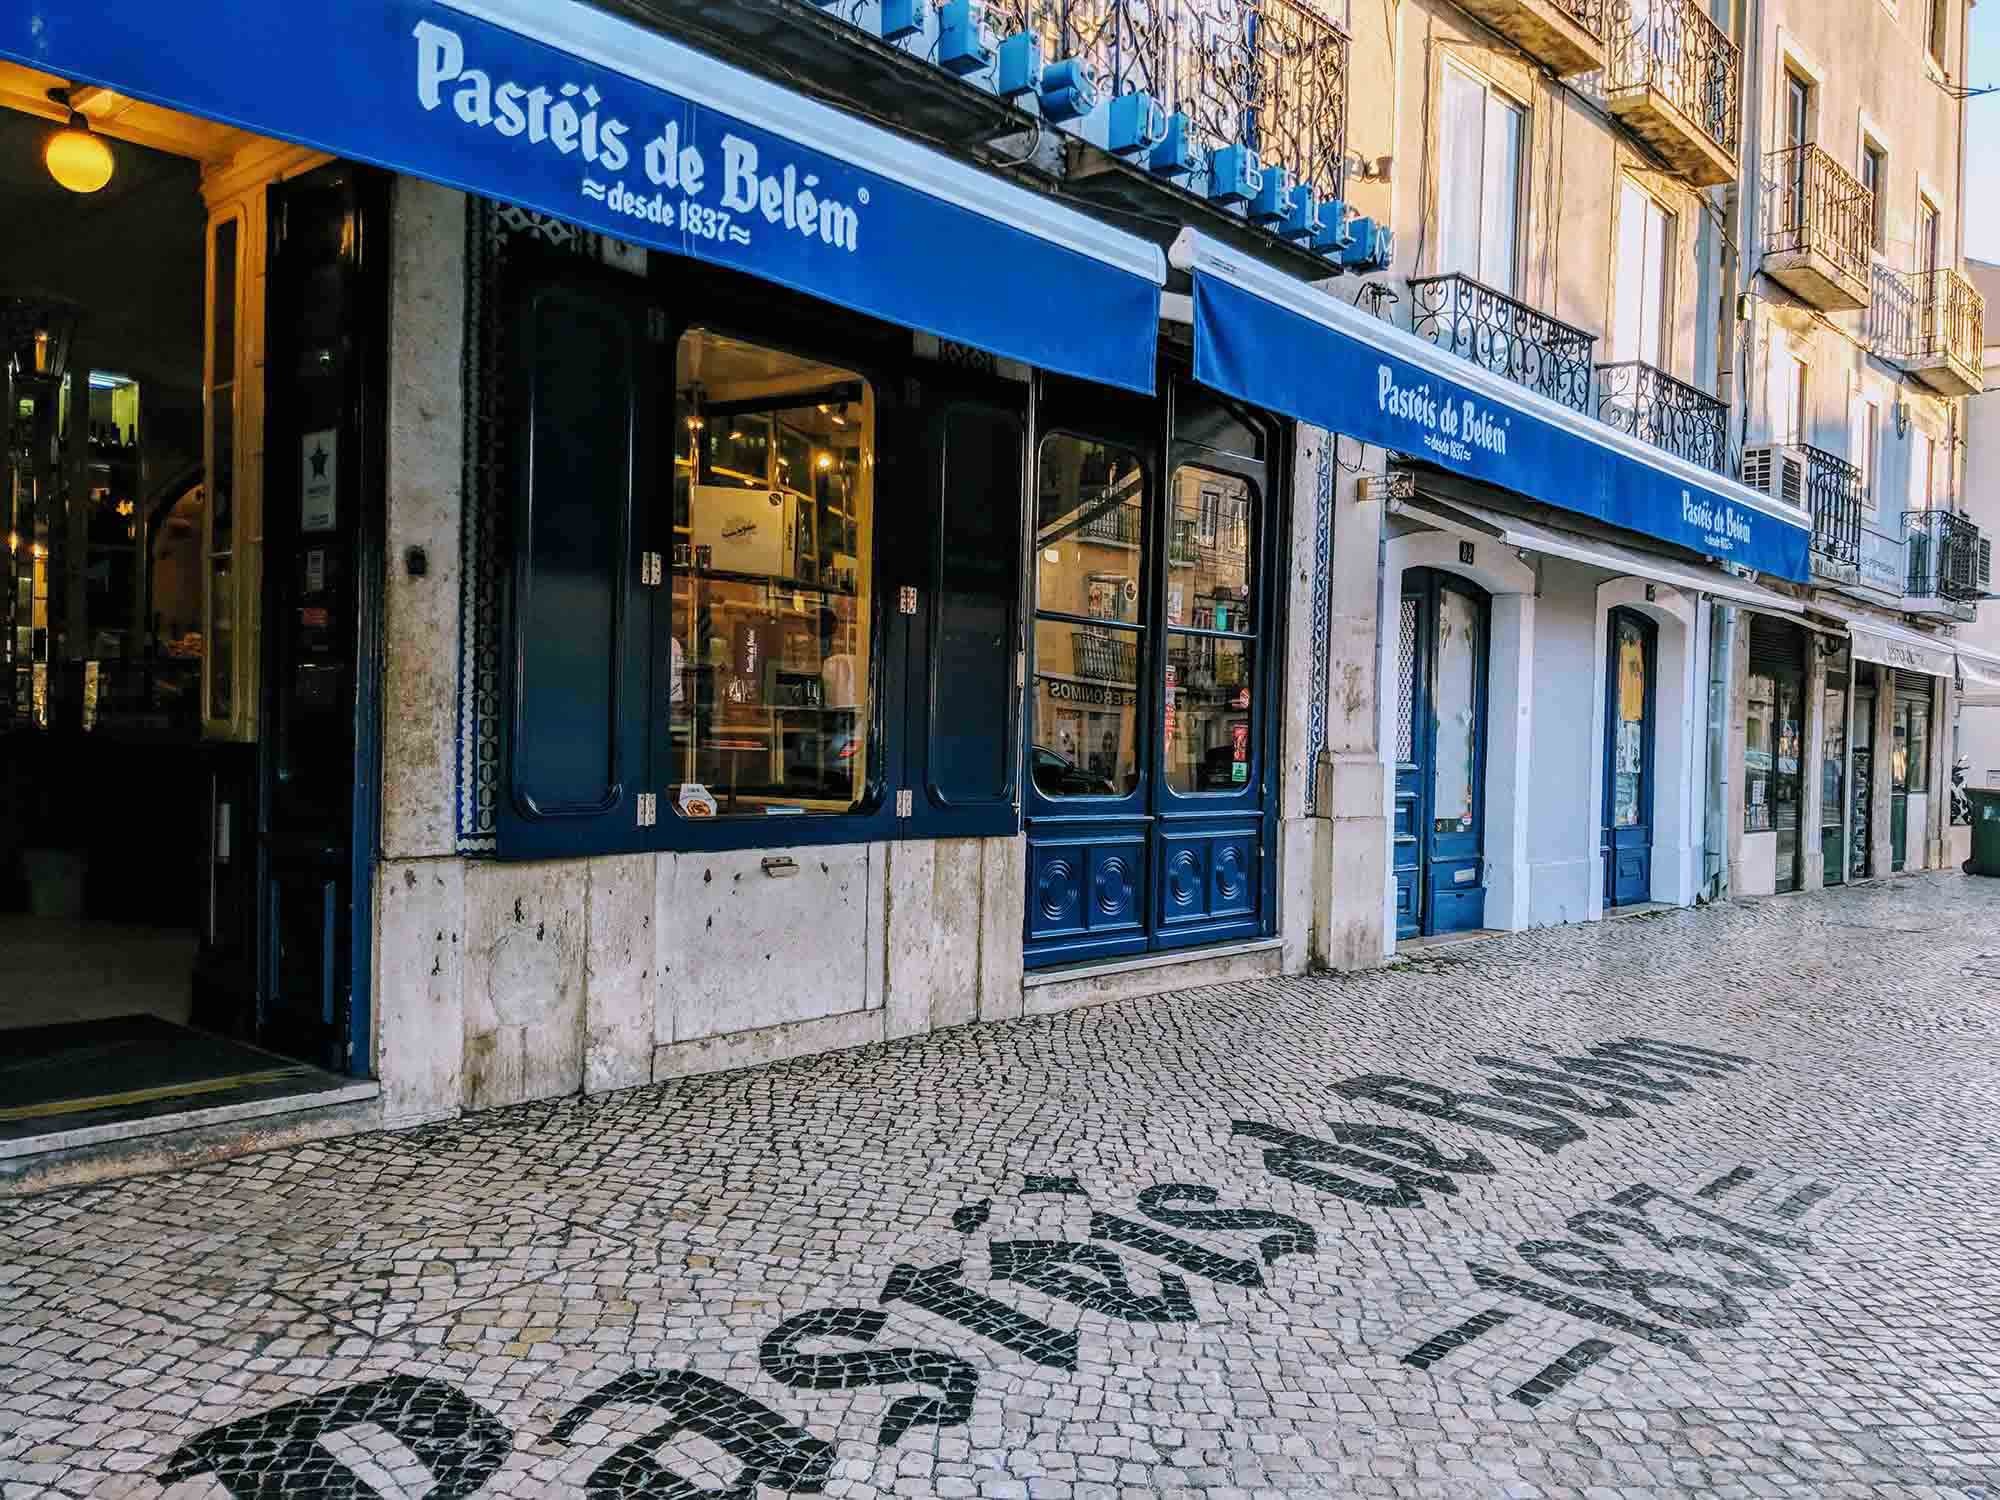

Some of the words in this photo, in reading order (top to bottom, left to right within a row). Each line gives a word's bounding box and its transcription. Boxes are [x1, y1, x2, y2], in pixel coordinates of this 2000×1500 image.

[644, 120, 705, 195] de
[607, 181, 675, 229] desde
[680, 201, 731, 243] 1837
[1440, 397, 1458, 437] de
[1714, 507, 1725, 535] de
[1231, 1118, 1498, 1208] de
